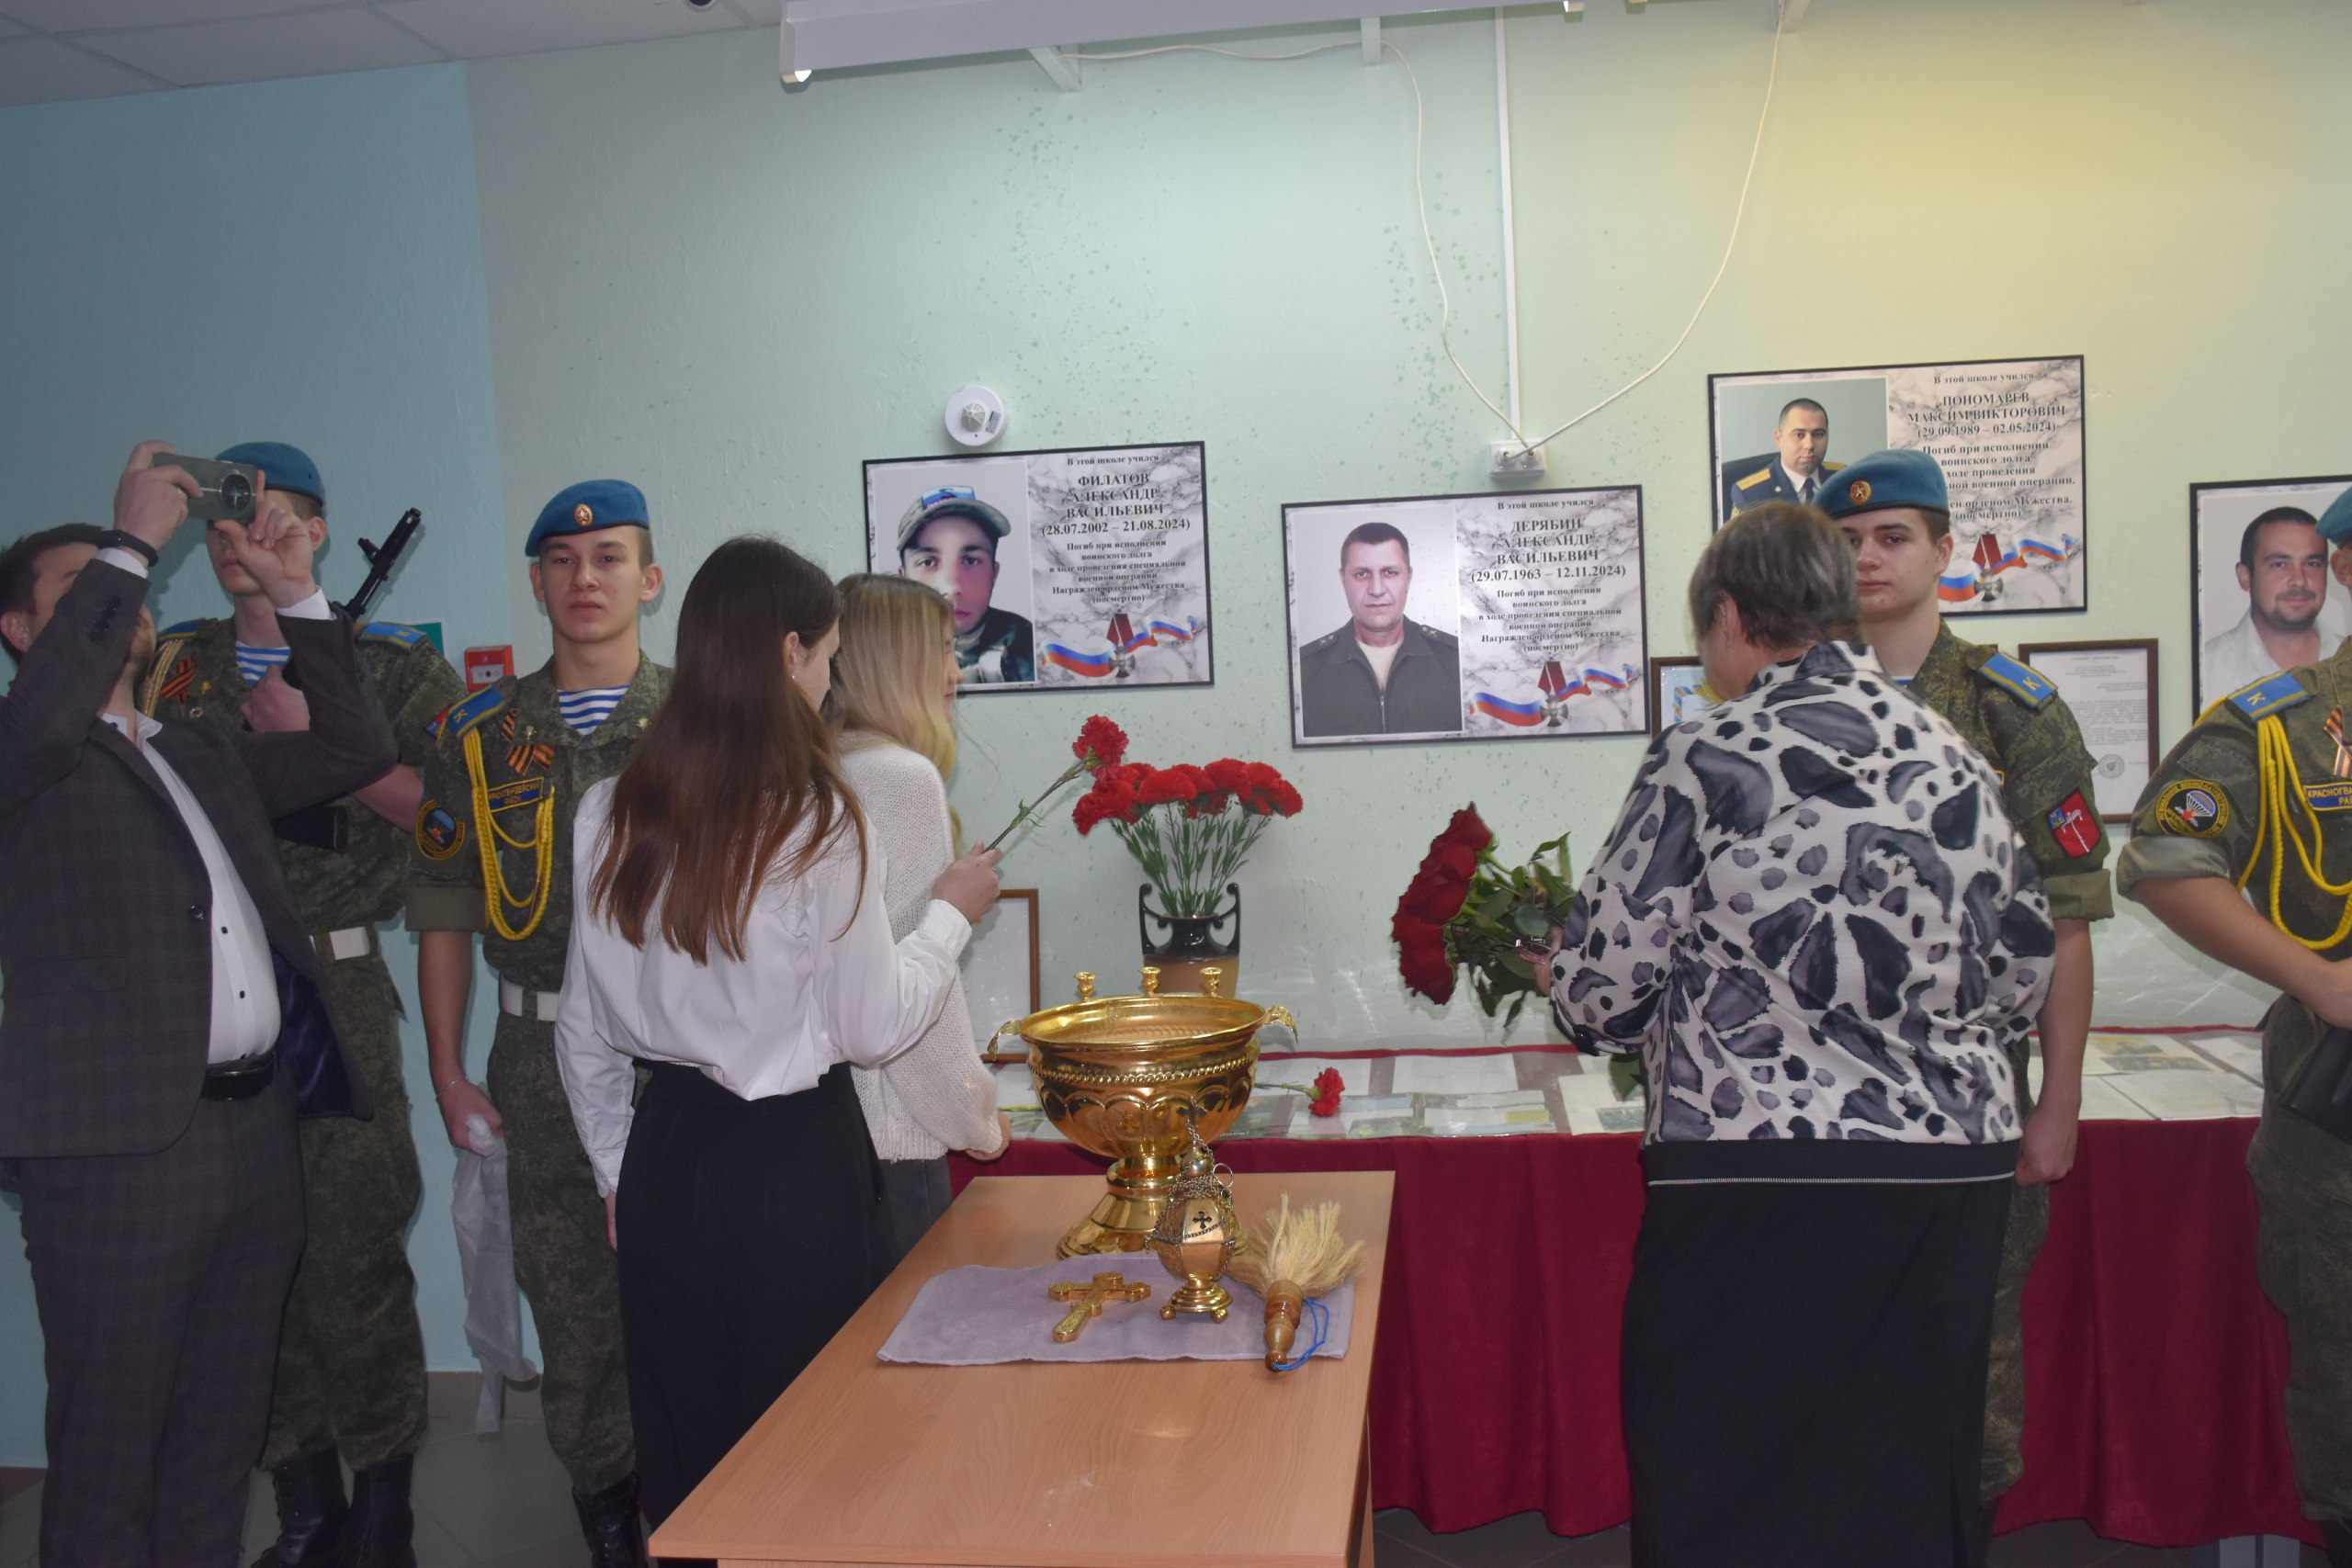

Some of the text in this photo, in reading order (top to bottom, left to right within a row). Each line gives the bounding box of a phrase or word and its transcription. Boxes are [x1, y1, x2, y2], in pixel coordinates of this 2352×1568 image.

[1944, 376, 1964, 384] этой
[1968, 374, 1997, 383] школе
[2000, 372, 2034, 382] учился
[1942, 392, 2030, 407] ПОНОМАРЕВ
[1908, 405, 2065, 423] МАКСИМ ВИКТОРОВИЧ
[1917, 424, 1980, 439] (29.09.1989
[1993, 422, 2056, 434] 02.05.2024)
[1923, 442, 2049, 456] Погиб при исполнении
[1067, 457, 1074, 466] В
[1097, 457, 1125, 465] школе
[1127, 455, 1159, 464] учился
[1941, 455, 2030, 467] воинского долга
[1947, 467, 2035, 478] ходе проведения
[1078, 472, 1149, 487] ФИЛАТОВ
[1972, 479, 2017, 489] военной
[2019, 476, 2075, 488] операции.
[1071, 487, 1159, 502] АЛЕКСАНДР
[1498, 499, 1594, 510] В этой школе учился
[1965, 498, 2010, 509] орденом
[2014, 495, 2073, 506] Мужества.
[1067, 503, 1164, 519] ВАСИЛЬЕВИЧ
[1955, 510, 2021, 521] (посмертно)
[1042, 522, 1109, 537] (28.07.2002
[1123, 518, 1191, 533] 21.08.2024)
[1511, 518, 1582, 534] ДЕРЯБИН
[1067, 539, 1167, 551] Погиб при исполнении
[1501, 534, 1593, 549] АЛЕКСАНДР
[1081, 551, 1152, 561] воинского долга
[1497, 549, 1599, 565] ВАСИЛЬЕВИЧ
[1077, 563, 1127, 573] проведения
[1129, 560, 1186, 570] специальной
[1078, 572, 1158, 582] военной операции
[1471, 569, 1542, 583] (29.07.1963
[1556, 565, 1626, 579] 12.11.2024)
[1052, 581, 1185, 595] Награжден орденом Мужества
[1497, 586, 1601, 598] Погиб при исполнении
[1092, 595, 1146, 604] (посмертно)
[1512, 598, 1587, 608] воинского долга
[1508, 611, 1560, 621] проведения
[1562, 607, 1622, 618] специальной
[1509, 620, 1592, 631] военной операции
[1481, 629, 1620, 644] Награжден орденом Мужества
[1523, 643, 1578, 652] (посмертно)
